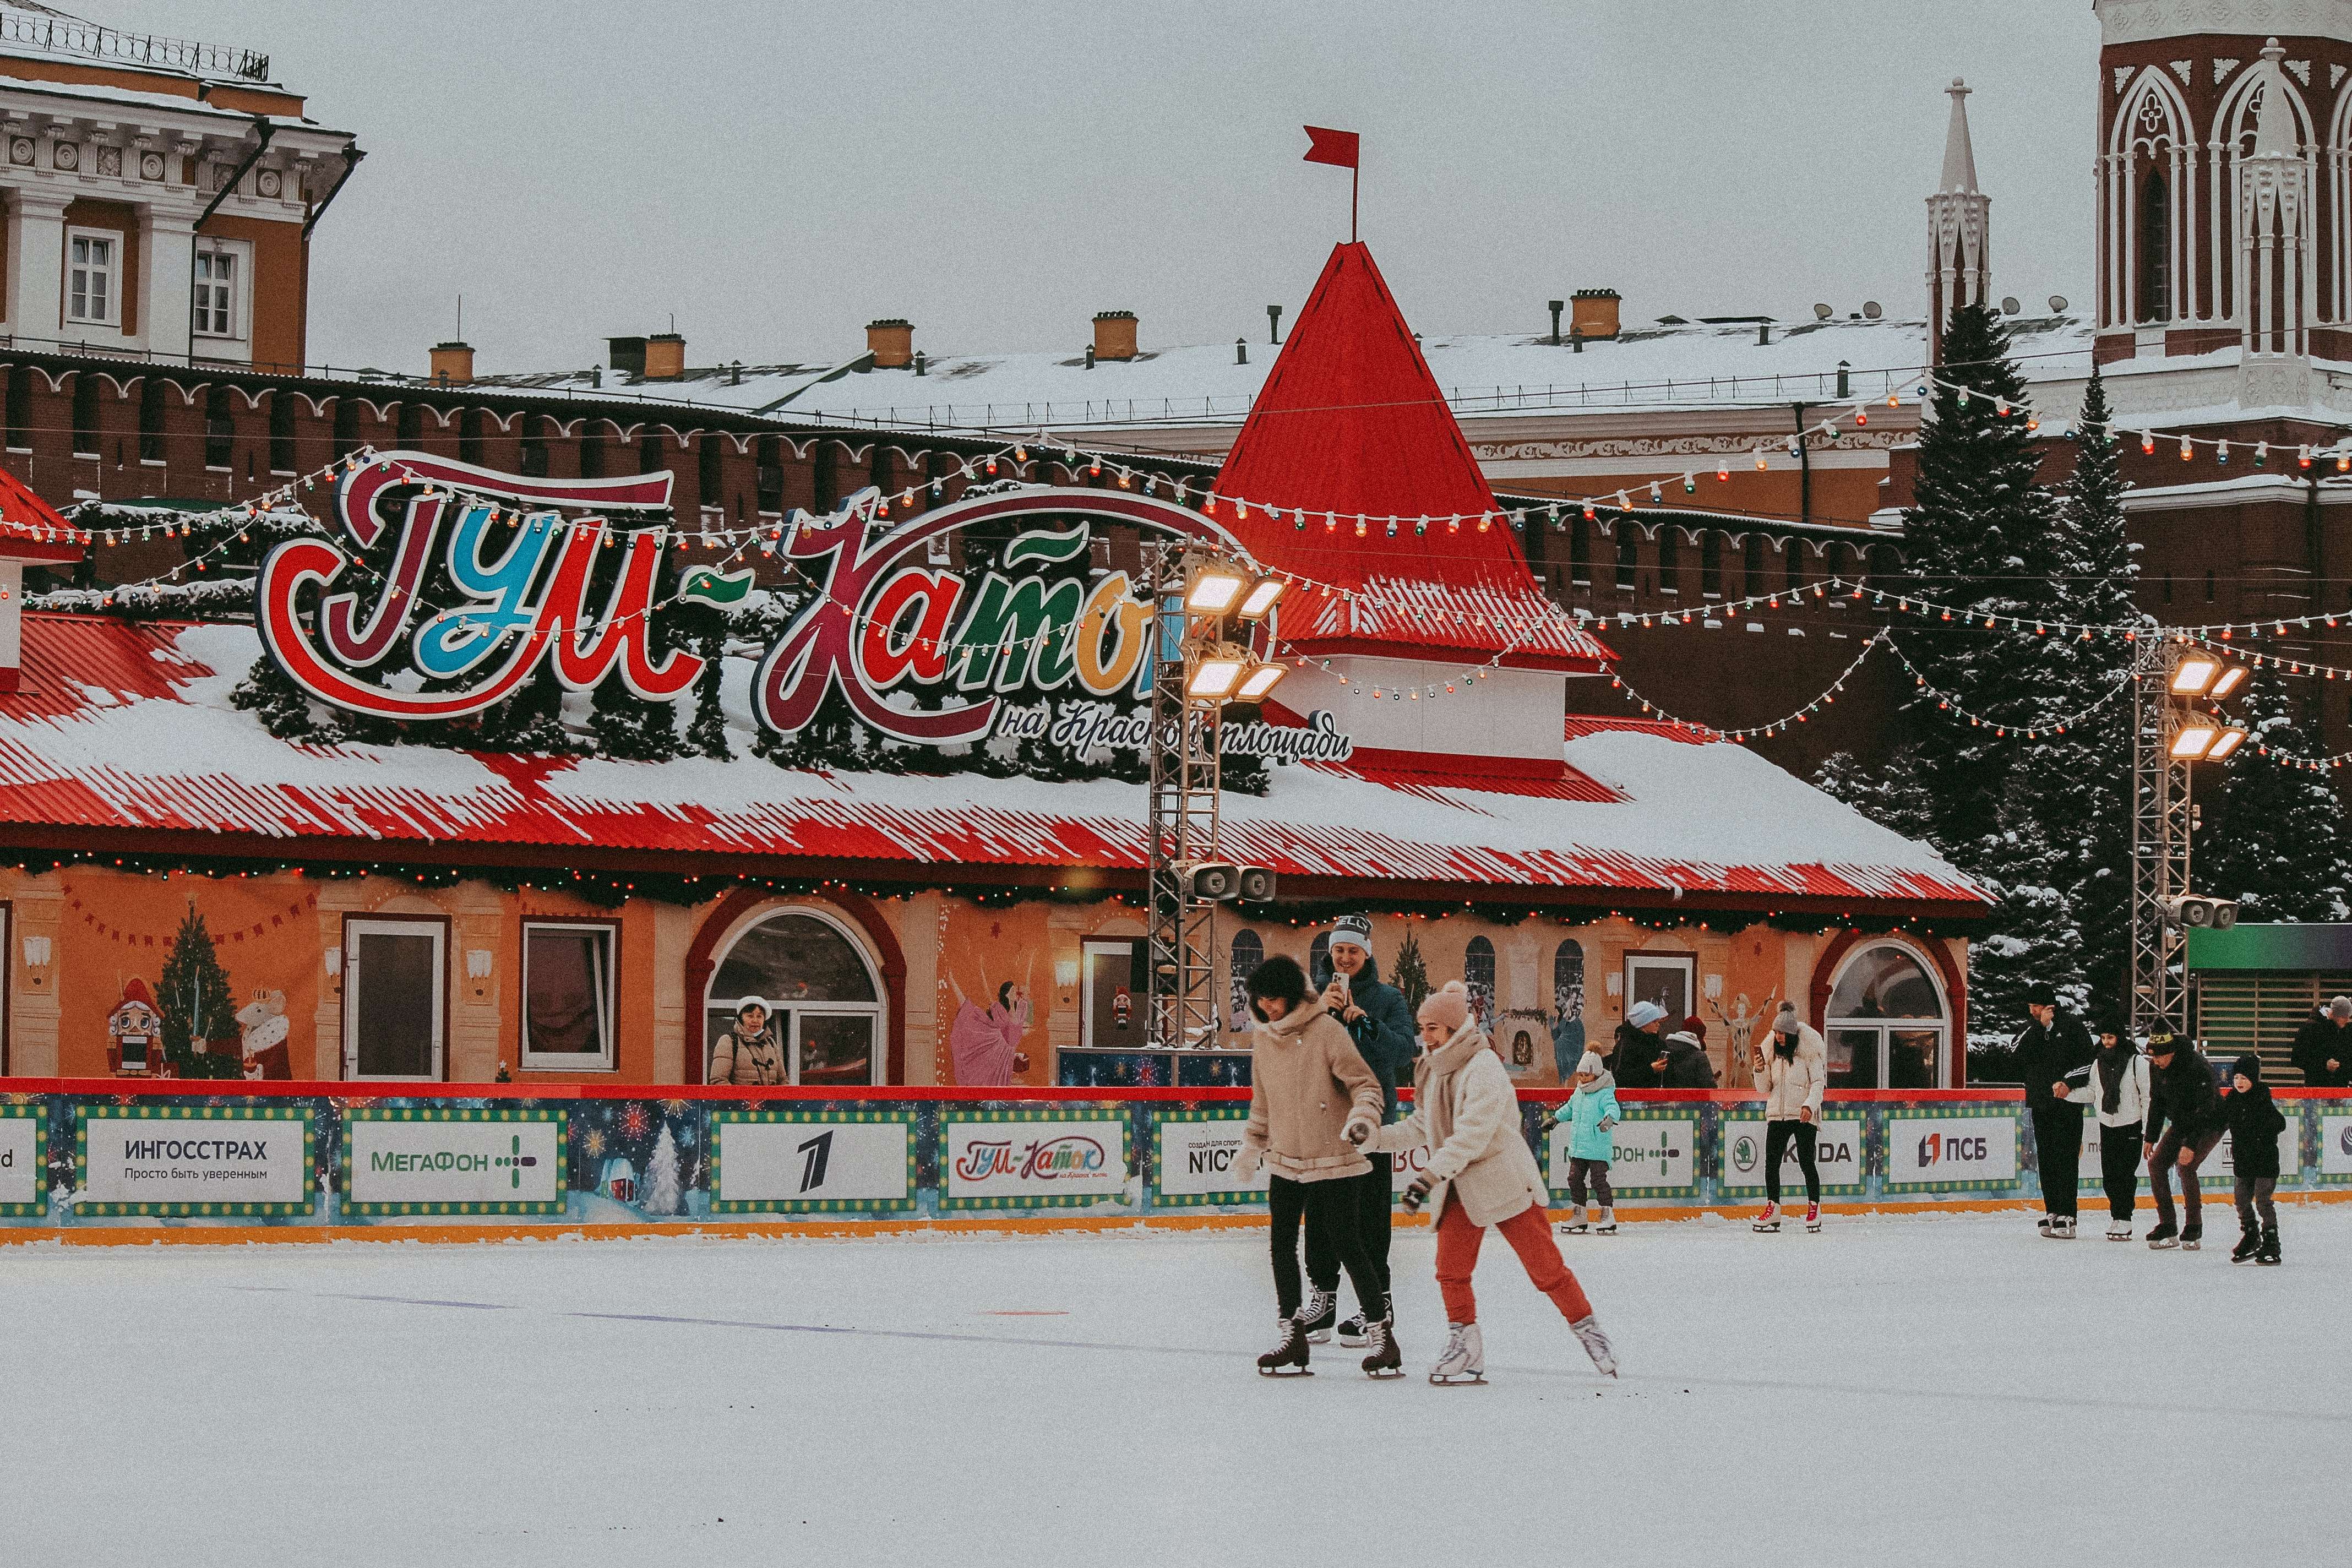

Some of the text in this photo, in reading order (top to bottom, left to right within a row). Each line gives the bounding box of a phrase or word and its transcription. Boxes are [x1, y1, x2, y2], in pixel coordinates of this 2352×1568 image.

[999, 704, 1049, 738] на
[1219, 710, 1353, 765] площади
[125, 1140, 268, 1159] ИНГОССТРАХ
[1188, 1141, 1211, 1149] СОЗДАН
[1946, 1137, 1987, 1161] ПСБ
[124, 1168, 268, 1181] Просто быть уверенным
